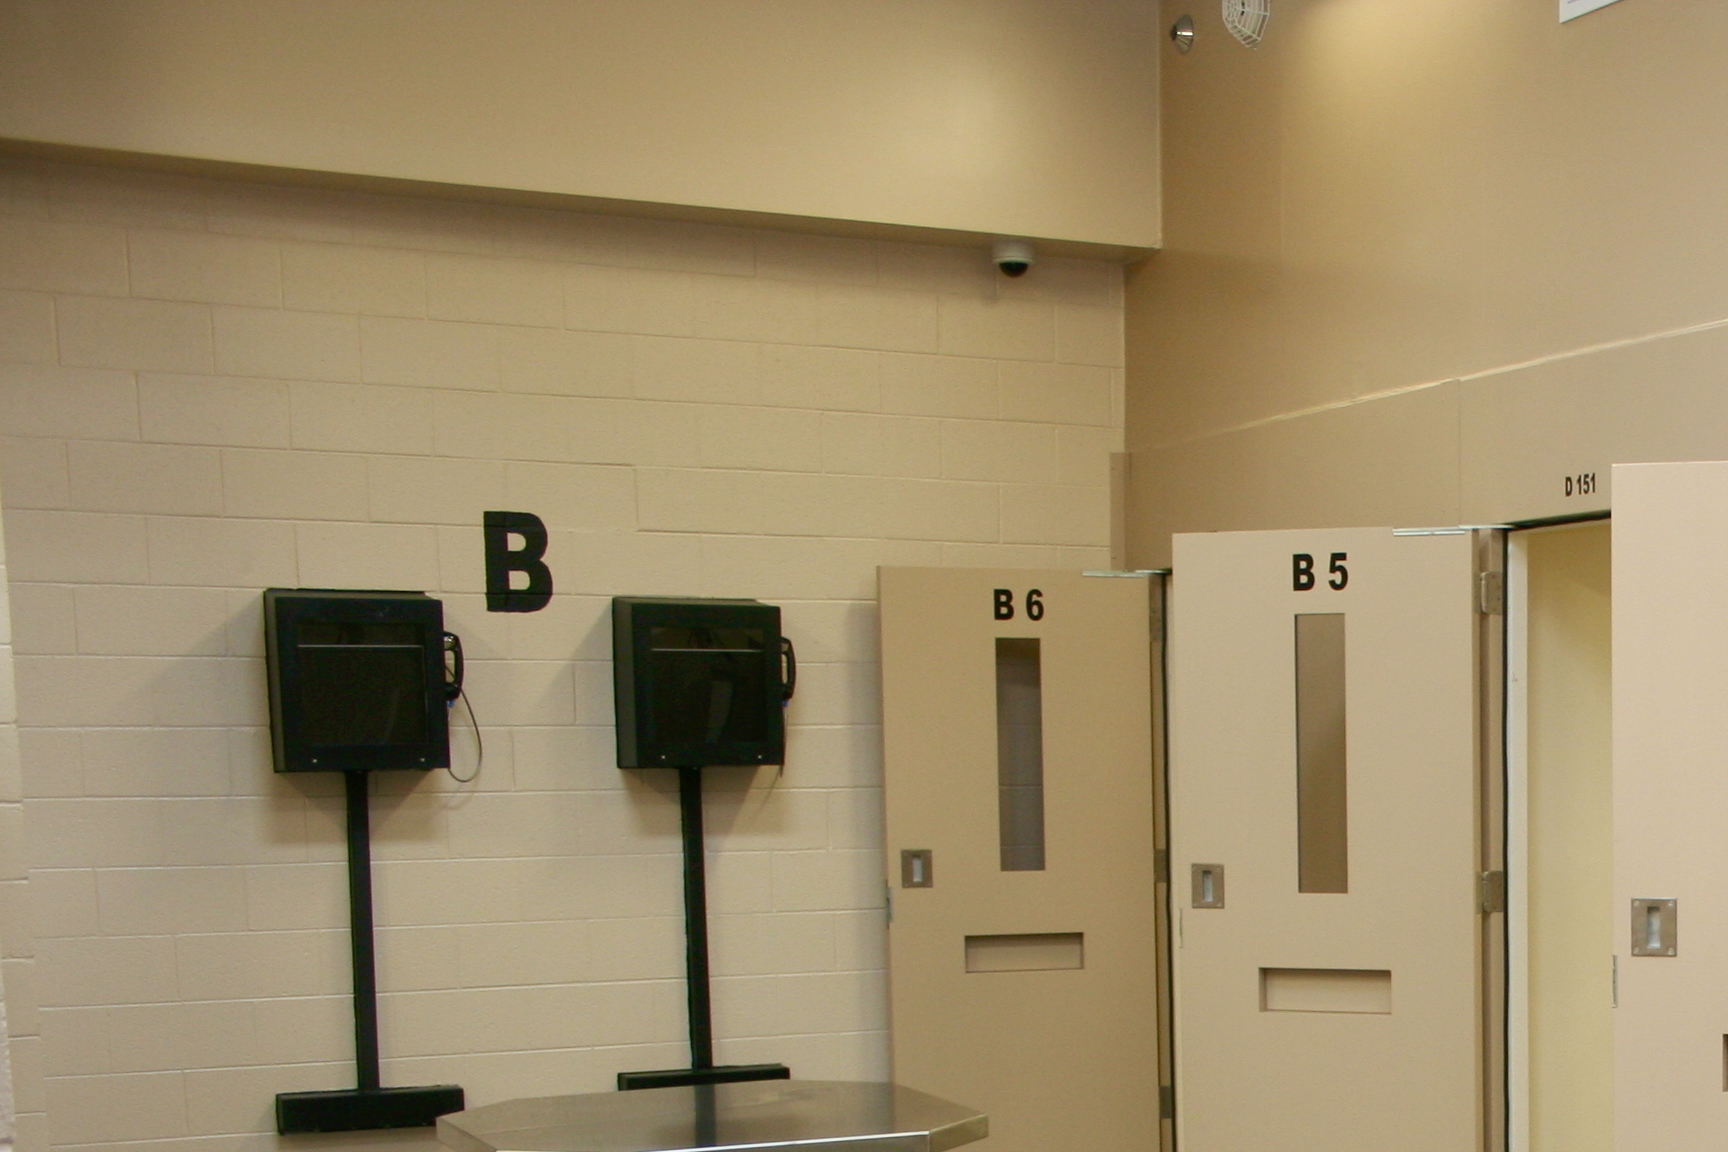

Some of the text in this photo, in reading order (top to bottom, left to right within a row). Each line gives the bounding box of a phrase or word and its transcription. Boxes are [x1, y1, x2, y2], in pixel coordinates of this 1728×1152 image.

[1565, 472, 1596, 497] D 151
[483, 510, 554, 613] B
[1292, 552, 1349, 592] B 5
[993, 588, 1045, 622] B 6
